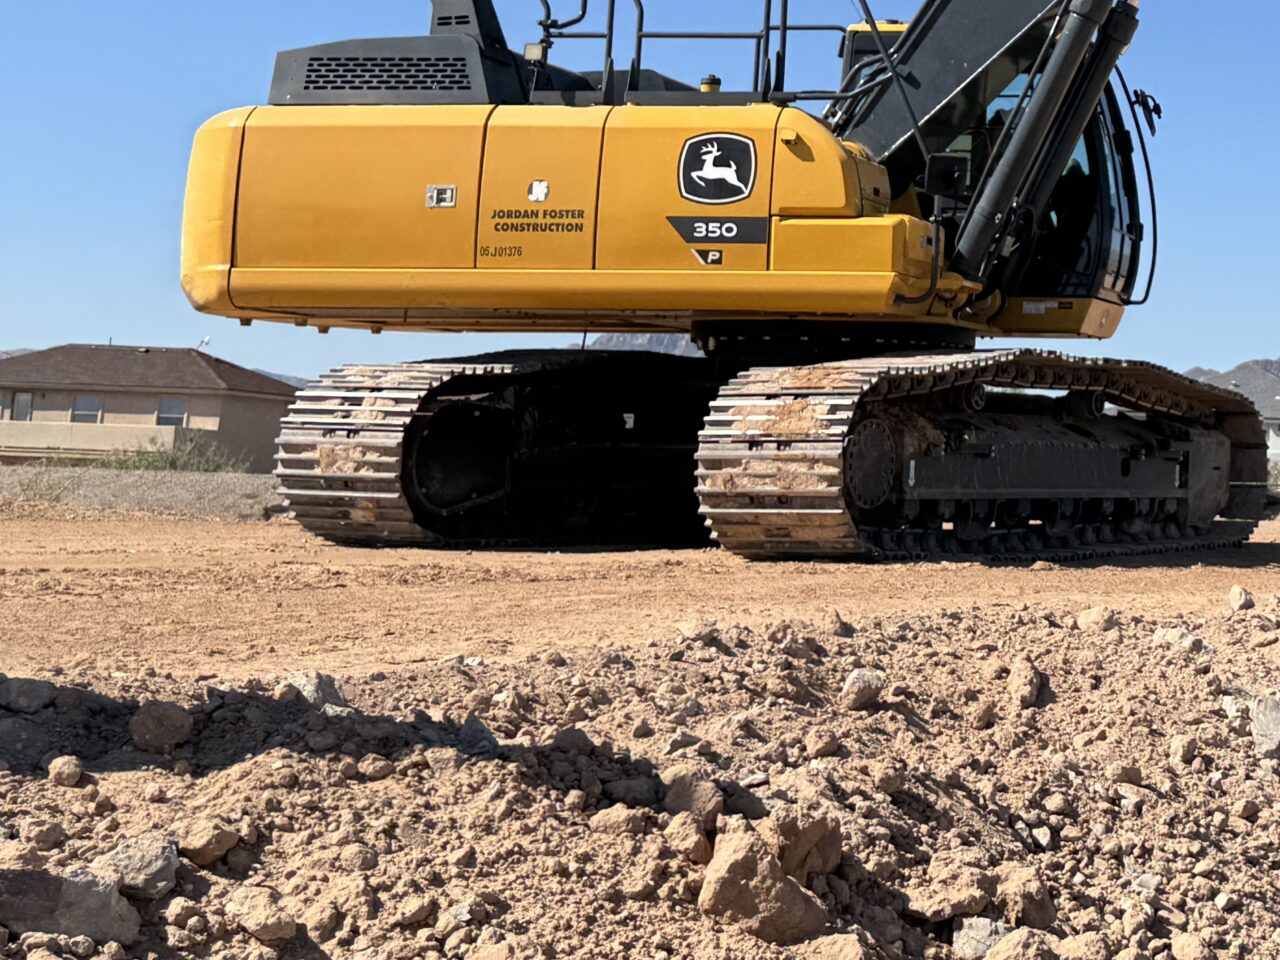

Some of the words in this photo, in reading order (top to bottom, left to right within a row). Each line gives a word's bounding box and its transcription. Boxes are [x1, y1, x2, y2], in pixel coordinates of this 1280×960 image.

[491, 209, 539, 219] JORDAN
[543, 209, 585, 219] FOSTER
[494, 222, 584, 233] CONSTRUCTION
[693, 222, 738, 238] 350
[707, 251, 721, 264] P
